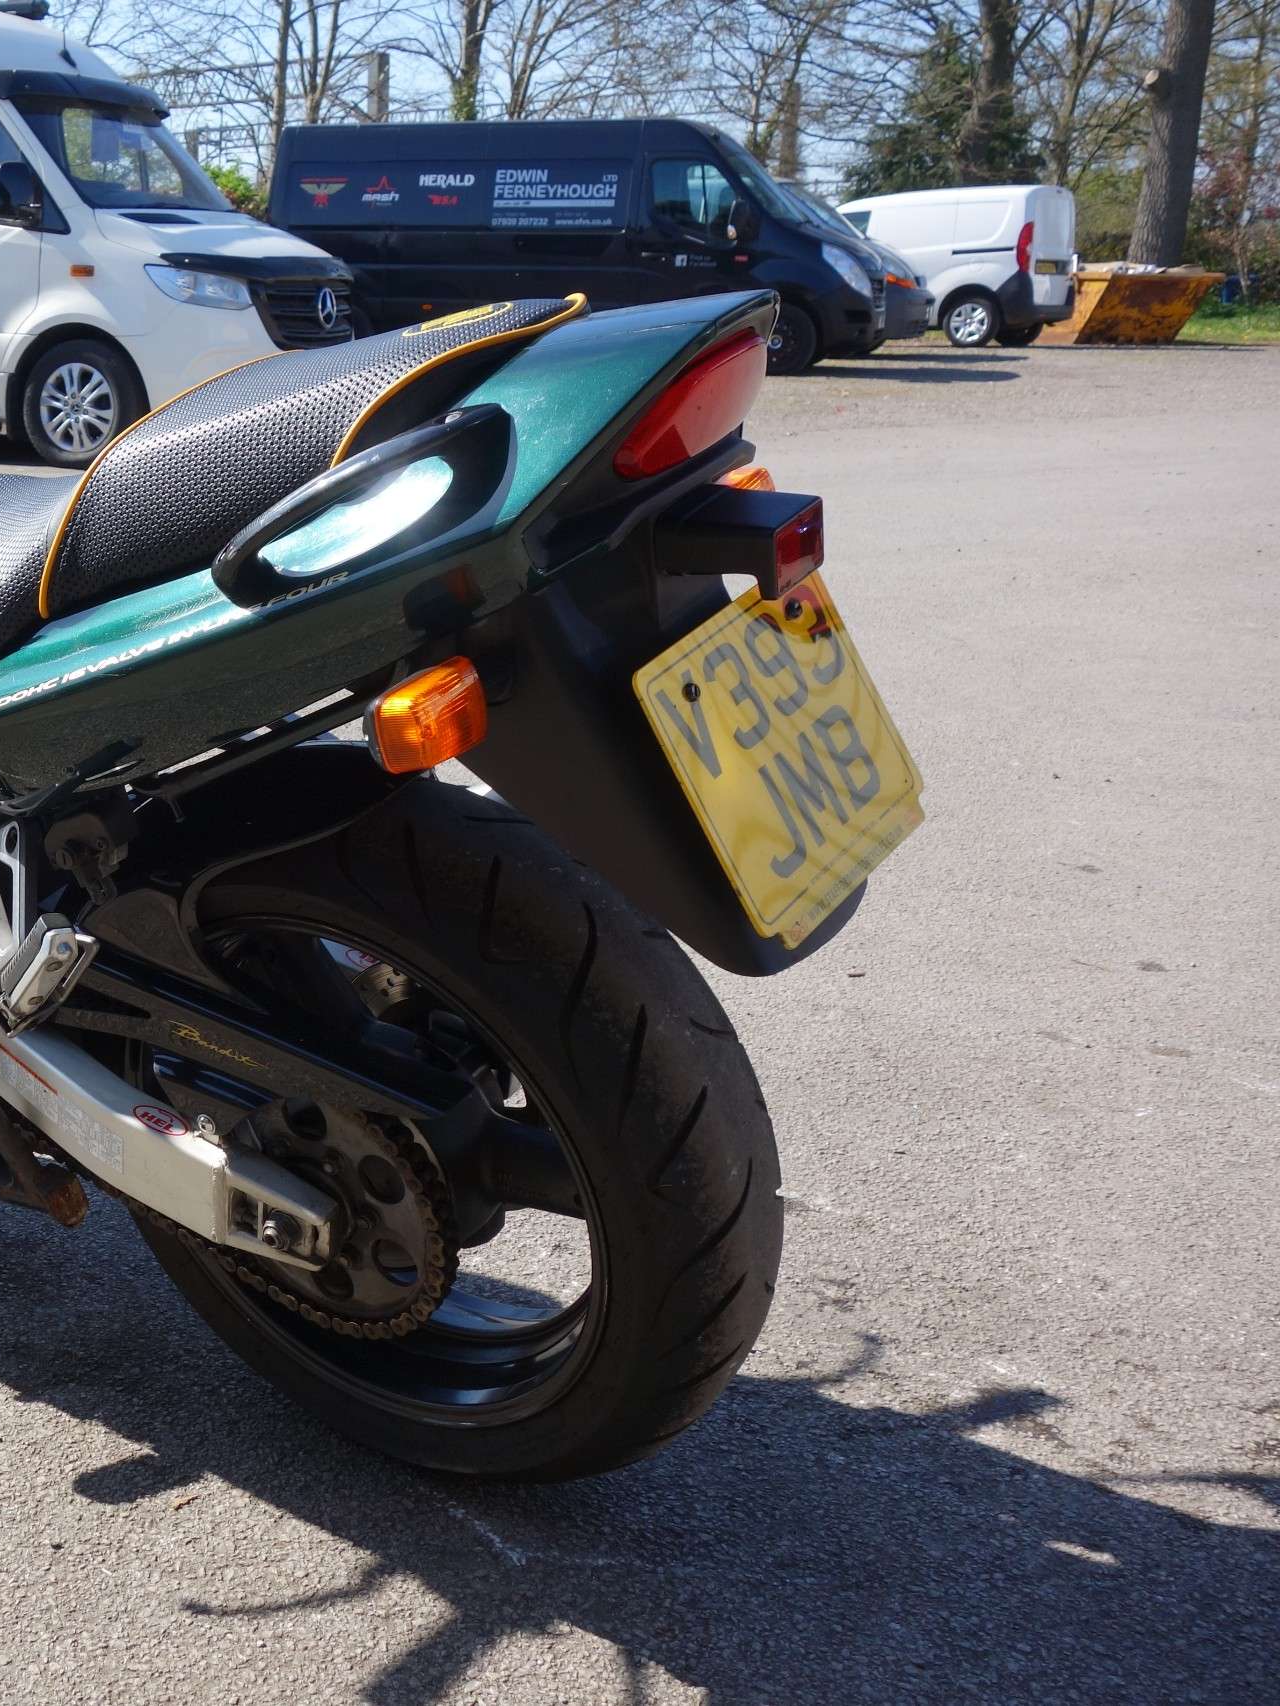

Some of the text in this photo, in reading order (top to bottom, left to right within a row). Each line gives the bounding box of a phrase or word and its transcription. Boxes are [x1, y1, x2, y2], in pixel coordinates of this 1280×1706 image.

[419, 174, 476, 188] HERALD
[495, 169, 548, 183] EDWIN
[603, 174, 618, 182] LTD
[494, 184, 617, 198] FERNEYHOUGH
[85, 638, 167, 673] VALVE
[265, 571, 349, 608] FOUR
[758, 704, 881, 878] JMB
[168, 1019, 267, 1068] Bandit
[138, 1111, 176, 1133] HEL
